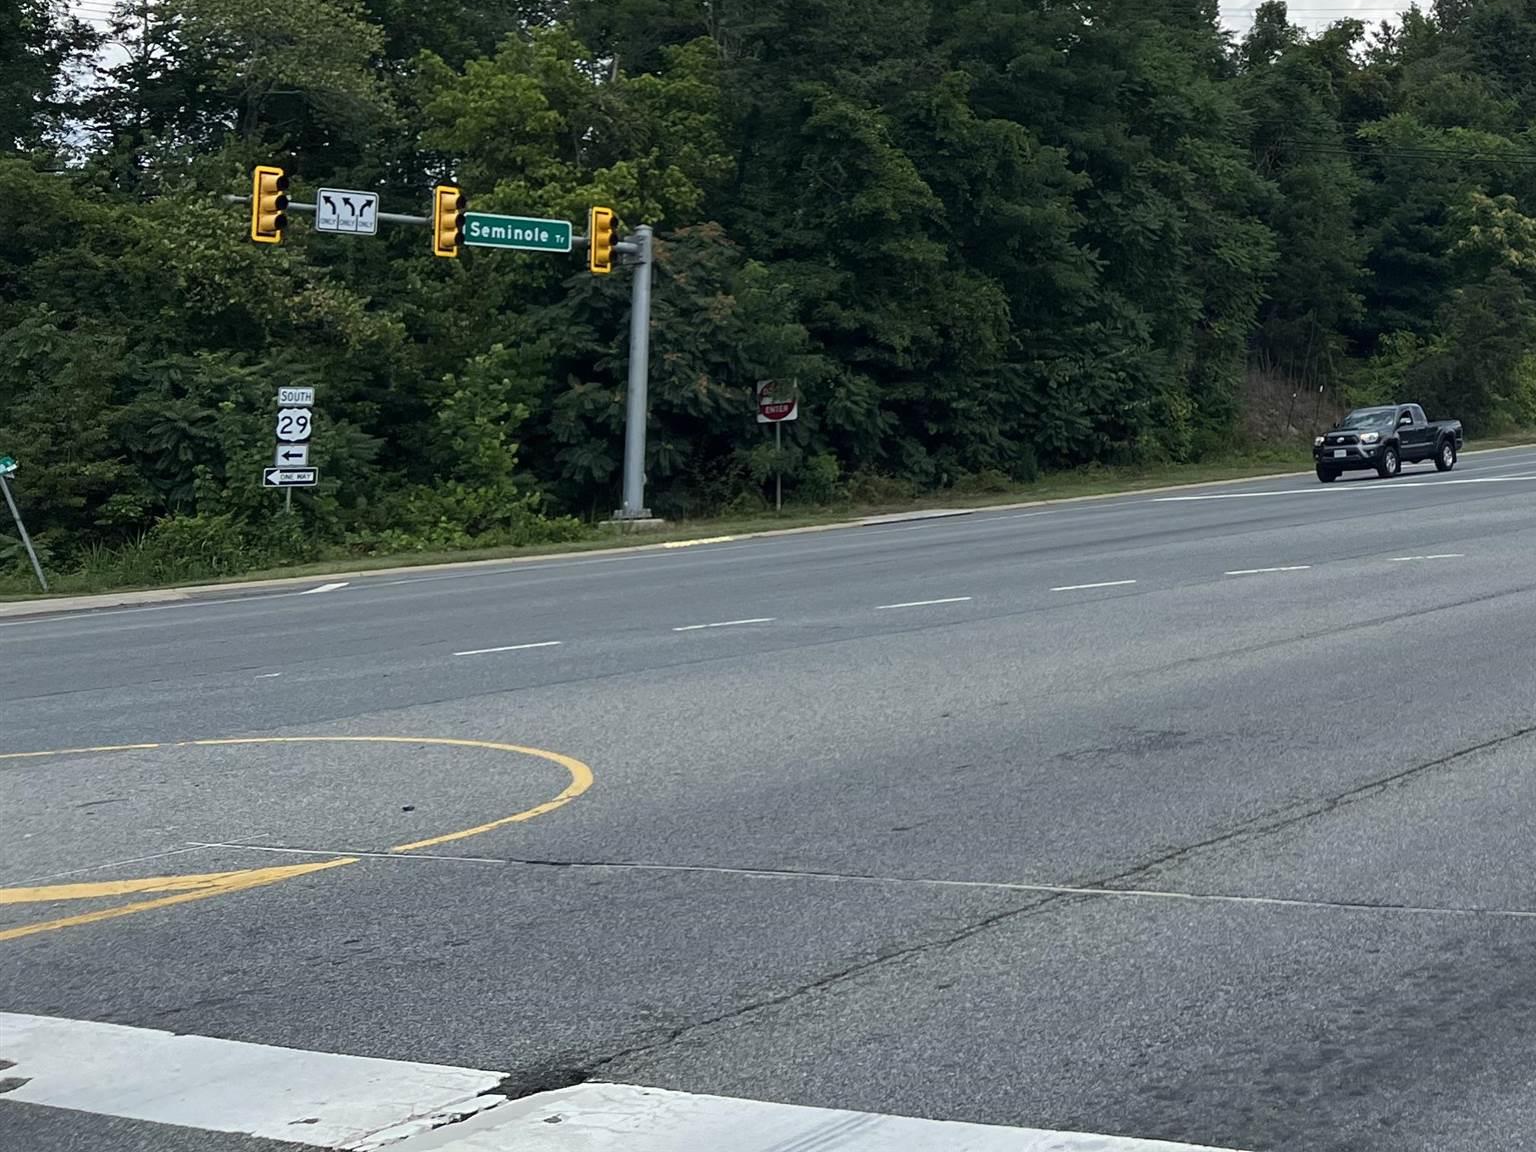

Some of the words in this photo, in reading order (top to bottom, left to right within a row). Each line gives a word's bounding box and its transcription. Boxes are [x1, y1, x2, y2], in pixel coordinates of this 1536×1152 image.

[470, 221, 549, 242] Seminole
[555, 234, 565, 244] Tr
[281, 391, 312, 402] SOUTH
[280, 416, 308, 434] 29
[280, 472, 294, 480] ONE
[297, 472, 312, 480] WAY
